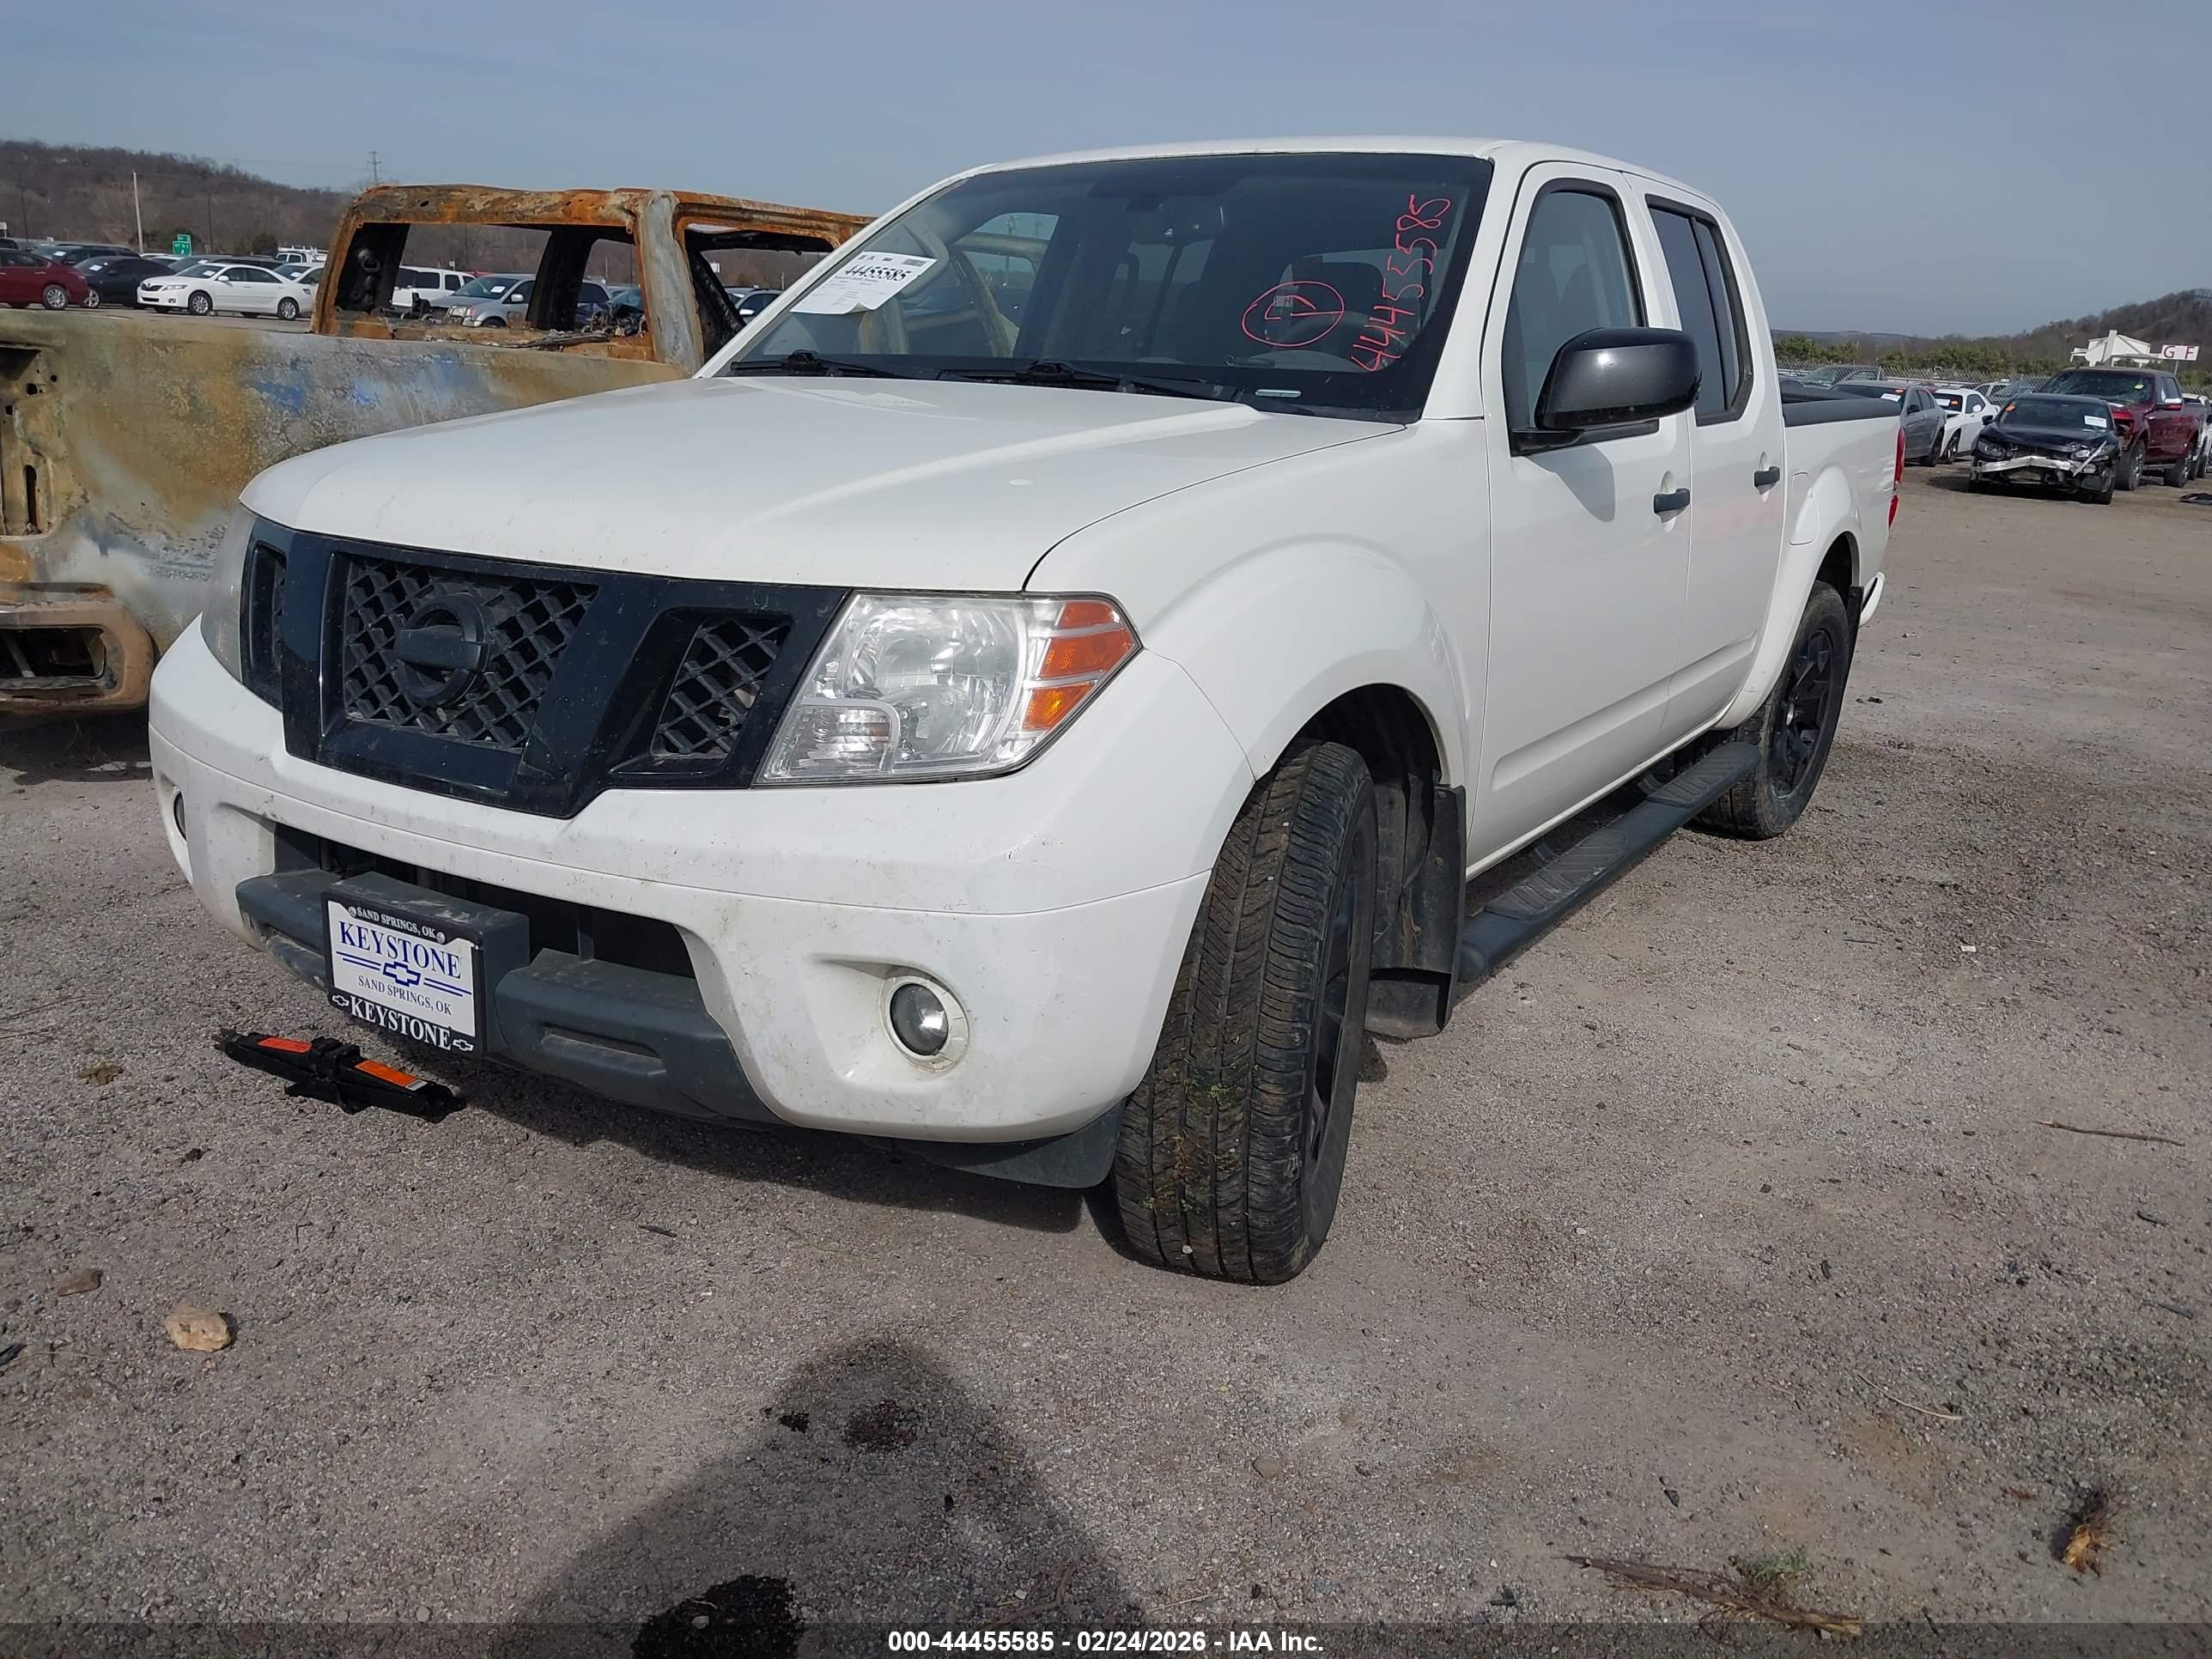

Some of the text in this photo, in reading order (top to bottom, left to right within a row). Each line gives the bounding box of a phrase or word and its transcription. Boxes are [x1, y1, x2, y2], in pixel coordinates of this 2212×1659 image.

[845, 264, 911, 282] 44455585
[1351, 194, 1451, 372] 44455585
[2164, 346, 2195, 359] G F
[357, 907, 437, 939] SAND SPRINGS, OK
[339, 921, 461, 978] KEYSTONE
[358, 975, 453, 1016] SAND SPRINGS, OK
[349, 995, 452, 1051] KEYSTONE
